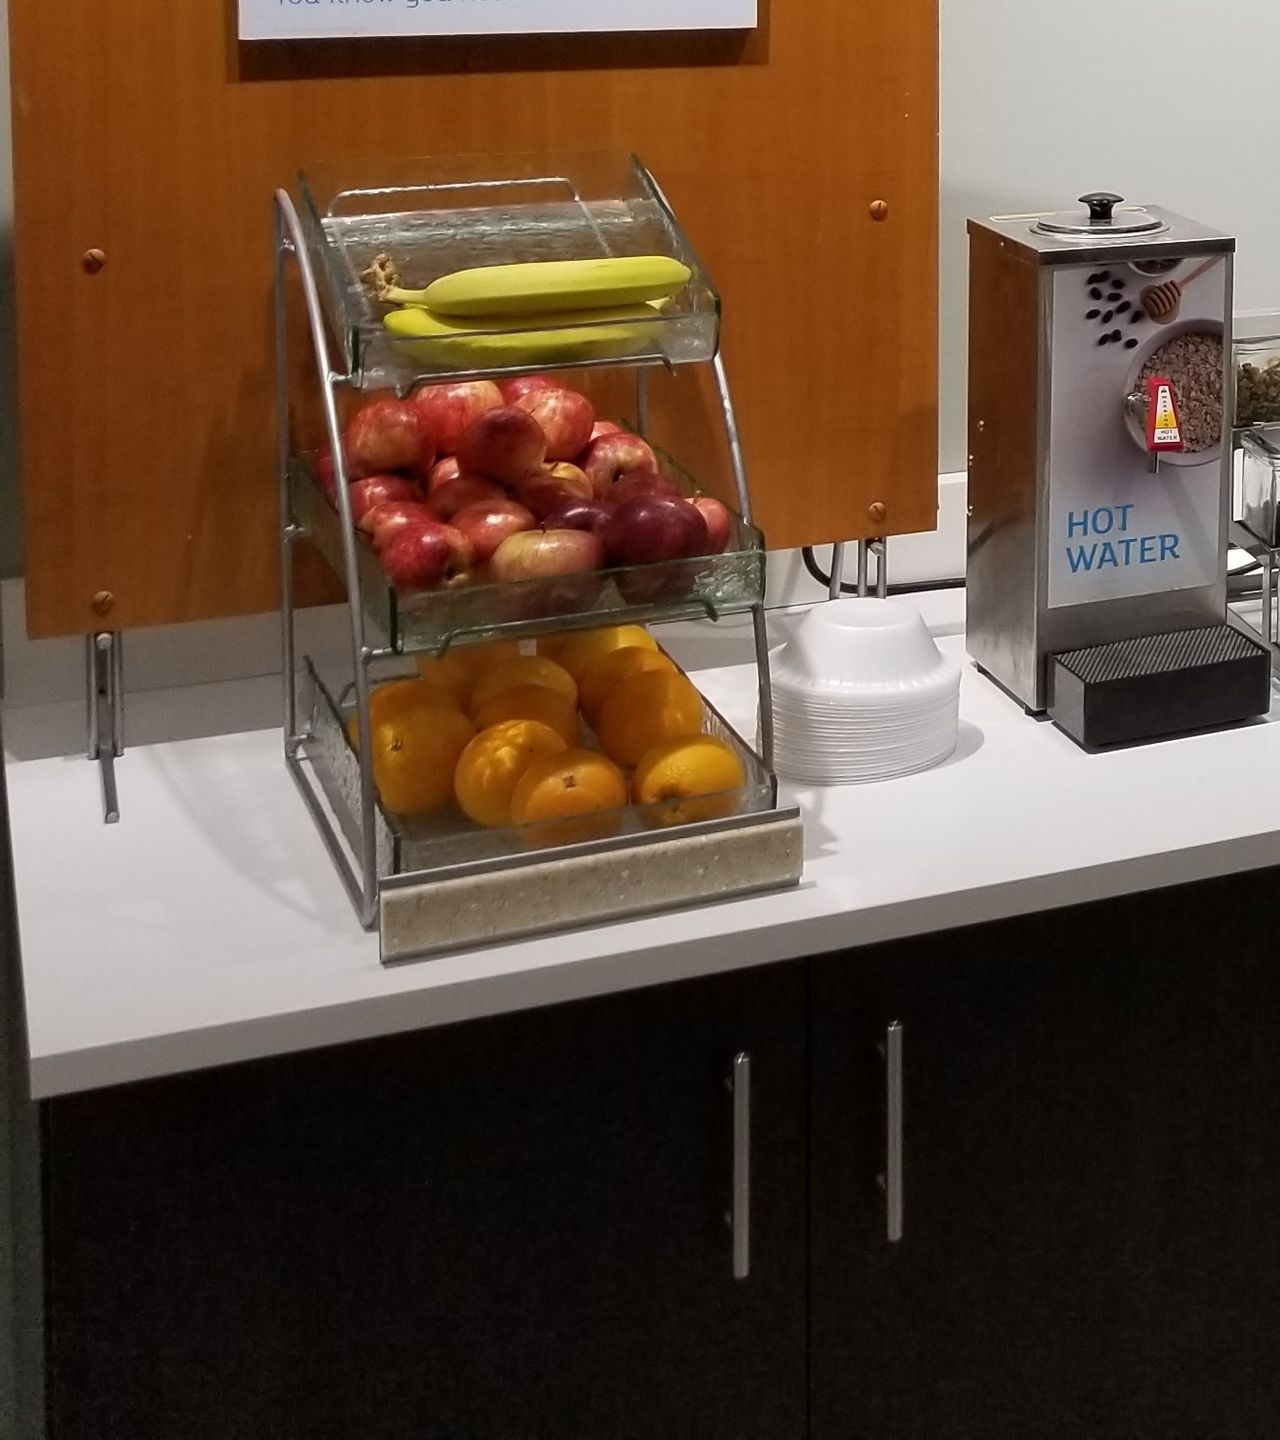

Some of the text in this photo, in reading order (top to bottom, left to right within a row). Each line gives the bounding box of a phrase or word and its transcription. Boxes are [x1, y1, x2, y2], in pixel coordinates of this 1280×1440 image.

[1160, 394, 1170, 428] WARNING
[1067, 503, 1135, 538] HOT
[1065, 533, 1180, 573] WATER
